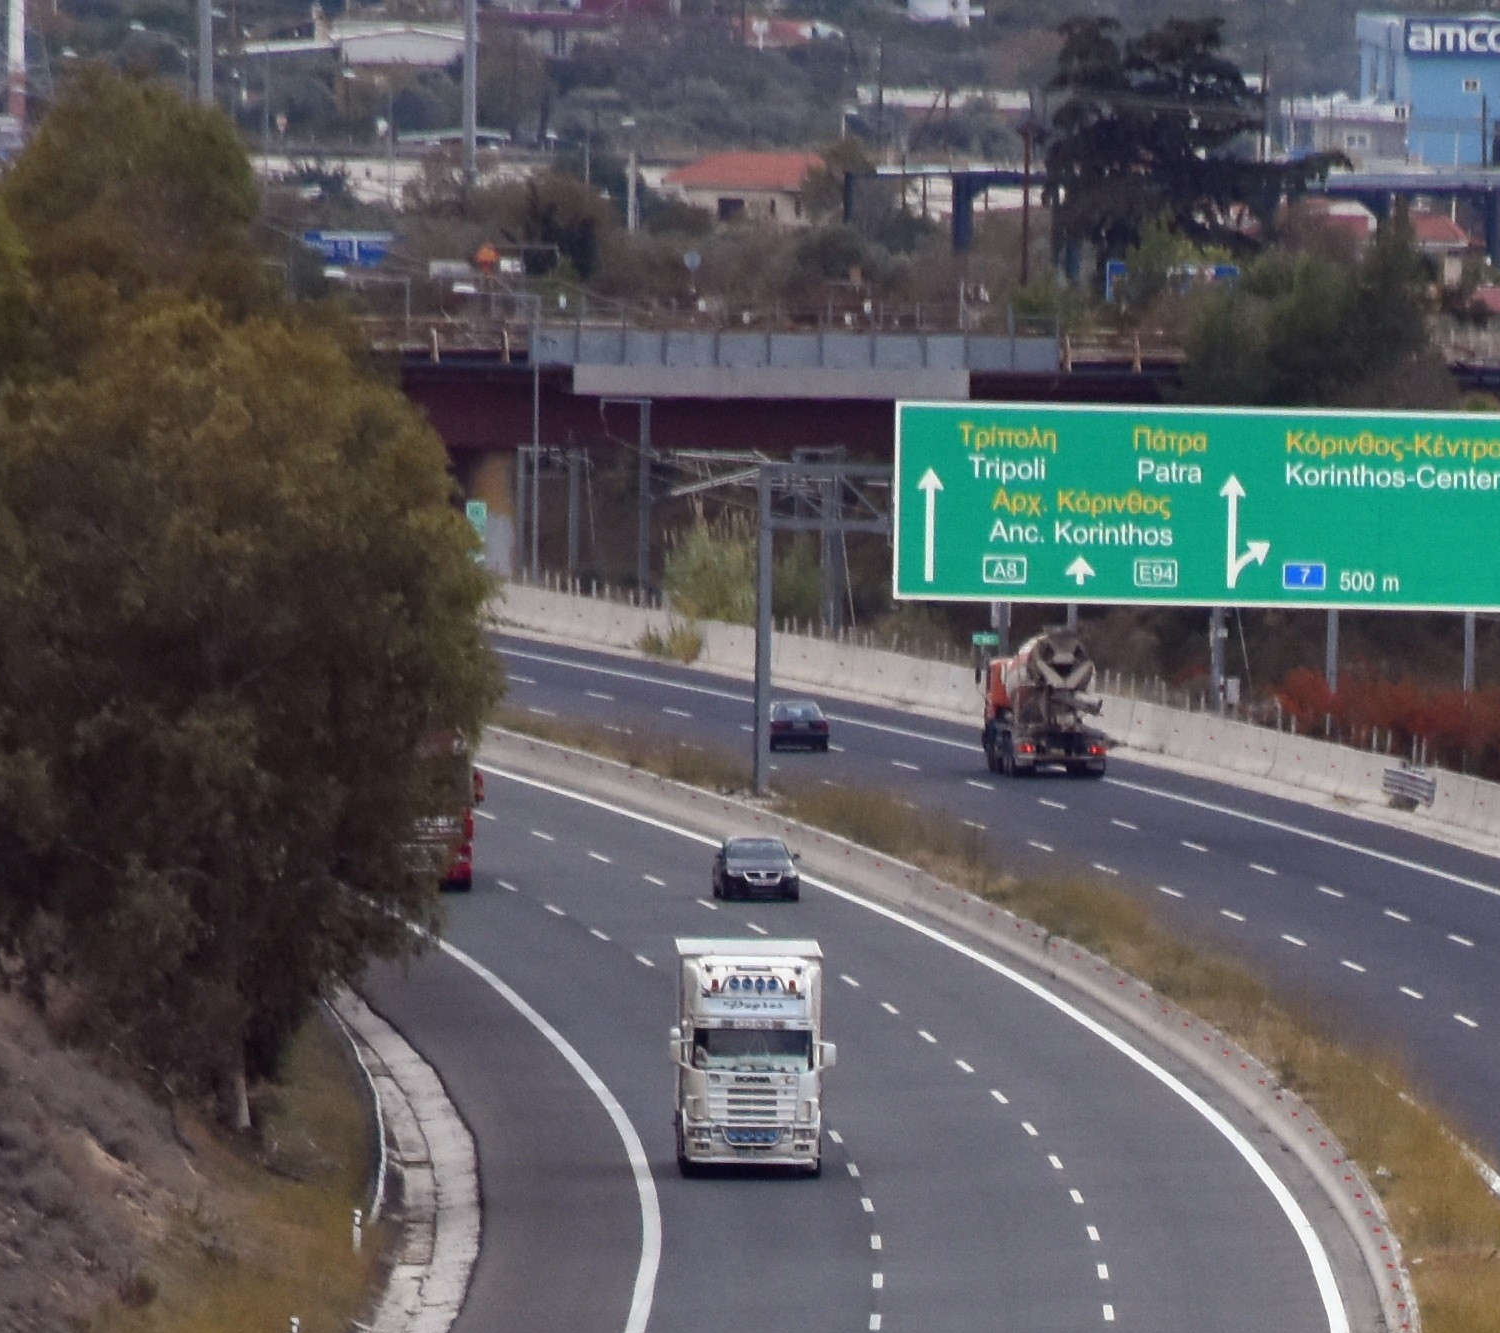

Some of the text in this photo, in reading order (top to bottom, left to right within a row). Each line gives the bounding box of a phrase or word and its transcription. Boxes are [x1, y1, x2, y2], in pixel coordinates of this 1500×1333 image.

[959, 421, 1057, 453] Τρίπολη
[1133, 426, 1207, 457] Πάτρα
[969, 456, 1046, 484] Tripoli
[1138, 458, 1203, 485] Patra
[992, 488, 1172, 520] Αρχ. Κόρινθος
[989, 519, 1173, 546] Anc. Korinthos
[993, 562, 1018, 579] A8
[1139, 565, 1173, 582] E94
[1301, 567, 1310, 584] 7
[1340, 571, 1399, 592] 500 m
